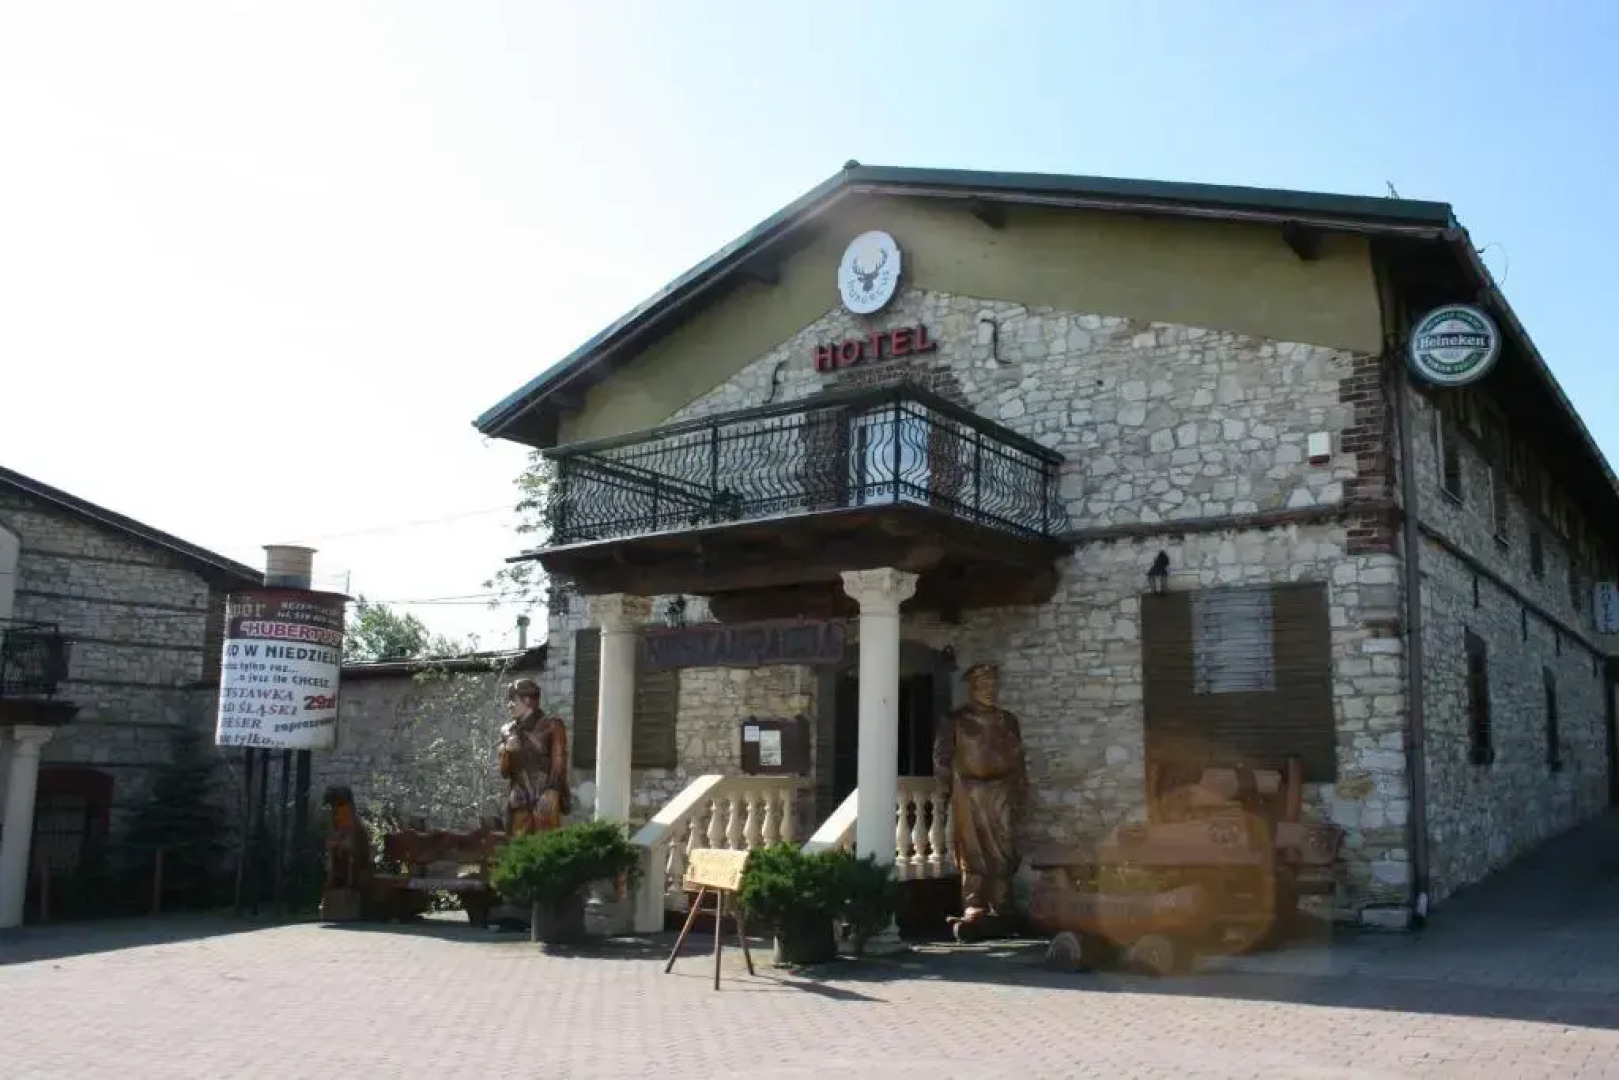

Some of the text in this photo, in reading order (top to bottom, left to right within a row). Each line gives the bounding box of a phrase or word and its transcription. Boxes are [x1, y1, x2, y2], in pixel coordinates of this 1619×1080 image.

[813, 324, 937, 373] HOTEL
[1420, 334, 1486, 349] Heineken
[244, 620, 341, 645] HUBERTUS
[244, 645, 258, 657] W
